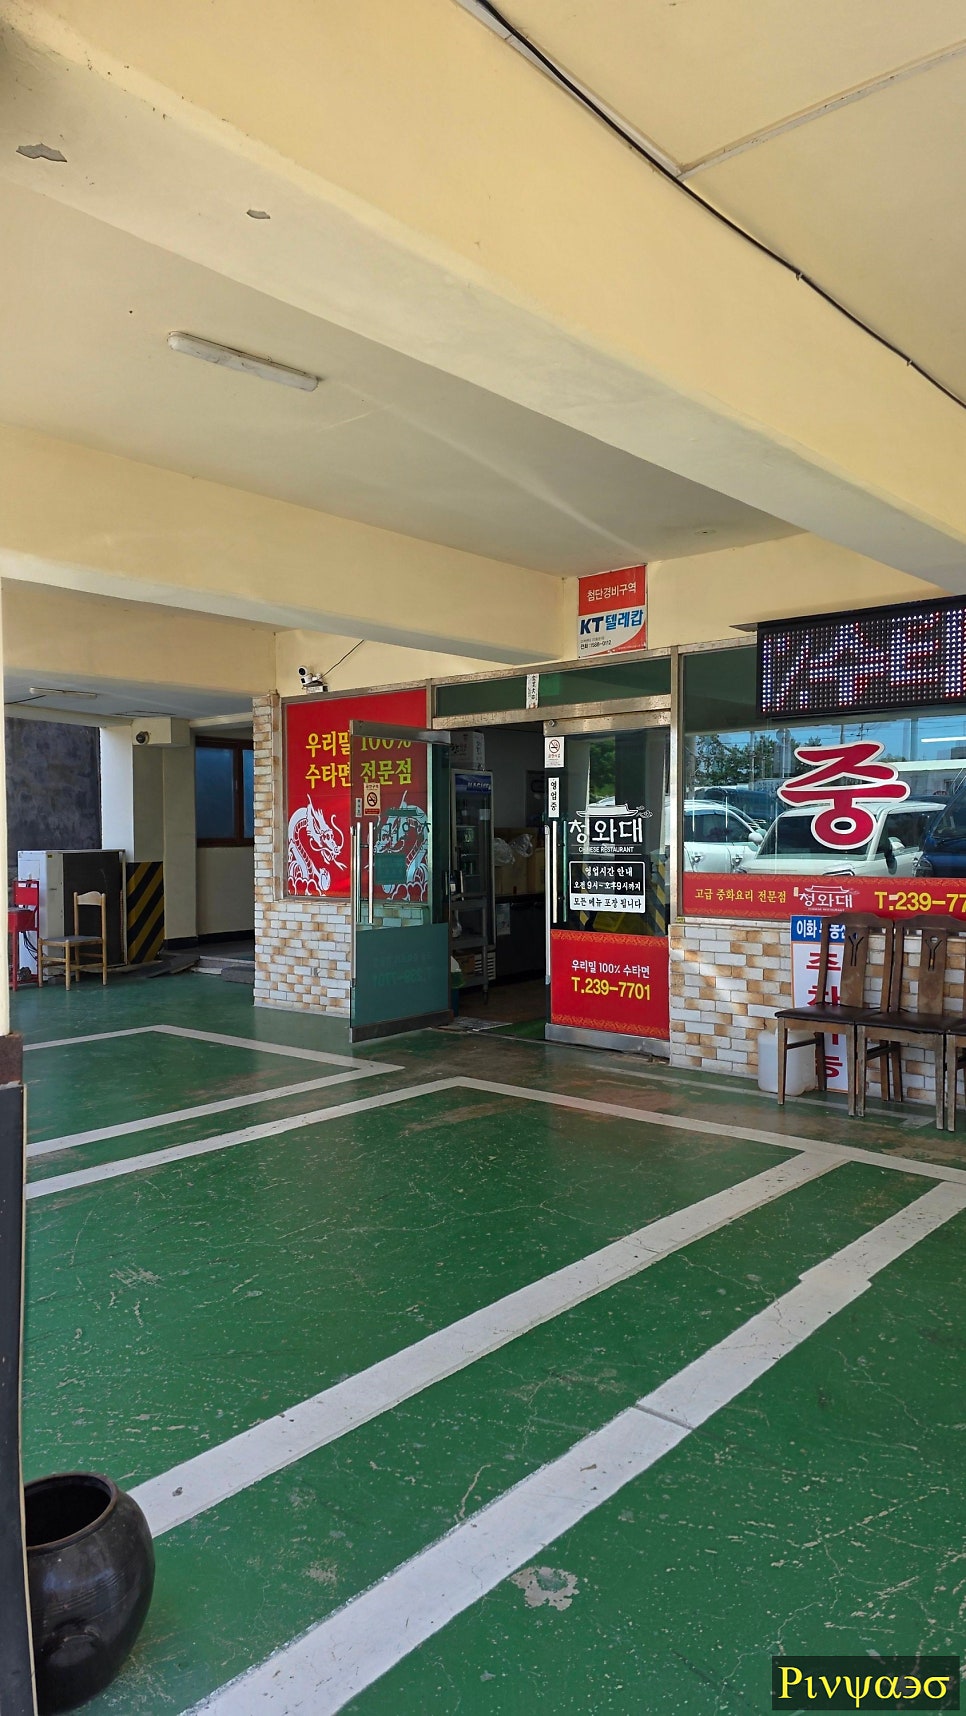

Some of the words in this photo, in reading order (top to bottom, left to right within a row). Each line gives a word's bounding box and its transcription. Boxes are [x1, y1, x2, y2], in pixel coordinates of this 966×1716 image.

[587, 582, 637, 602] 첨단경비구역
[305, 731, 352, 757] 우리밀
[305, 762, 353, 790] 수타면
[360, 758, 412, 786] 전문점
[777, 740, 911, 850] 중
[568, 818, 643, 844] 청와대
[585, 866, 615, 877] 영업시간
[616, 866, 633, 877] 안내
[694, 888, 713, 900] 고급
[716, 888, 753, 903] 중화요리
[757, 889, 786, 903] 전문점
[798, 892, 853, 908] 청와대
[571, 959, 596, 974] 우리밀
[599, 962, 621, 974] 100%
[623, 965, 650, 979] 수타면
[571, 976, 651, 1001] T.239-7701
